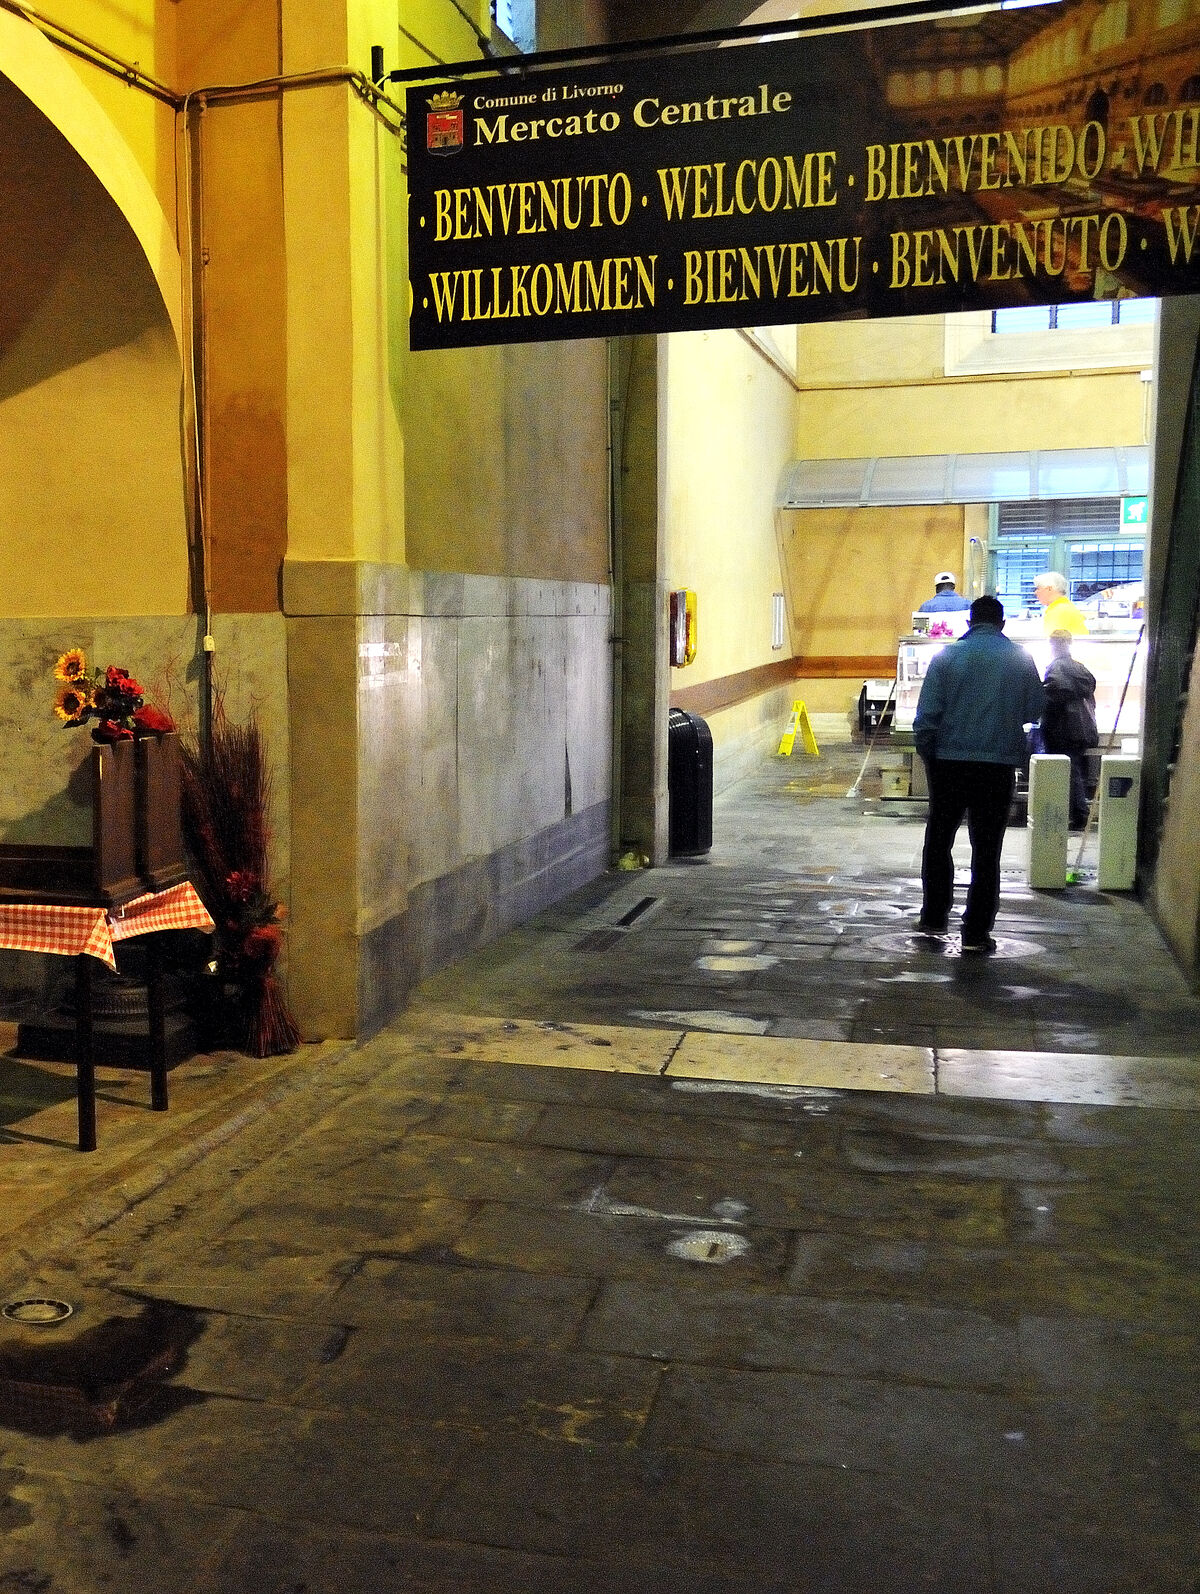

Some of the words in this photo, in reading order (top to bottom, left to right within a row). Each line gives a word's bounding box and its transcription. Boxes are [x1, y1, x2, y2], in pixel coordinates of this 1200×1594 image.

[473, 92, 537, 110] Comune
[541, 87, 557, 102] di
[562, 82, 624, 100] Livorno
[473, 109, 621, 146] Mercato
[633, 84, 792, 128] Centrale
[434, 172, 632, 242] BENVENUTO
[656, 151, 838, 221] WELCOME
[864, 120, 1107, 202] BIENVENIDO
[429, 255, 658, 323] WILLKOMMEN
[684, 237, 862, 305] BIENVENU
[889, 213, 1128, 289] BENVENUTO
